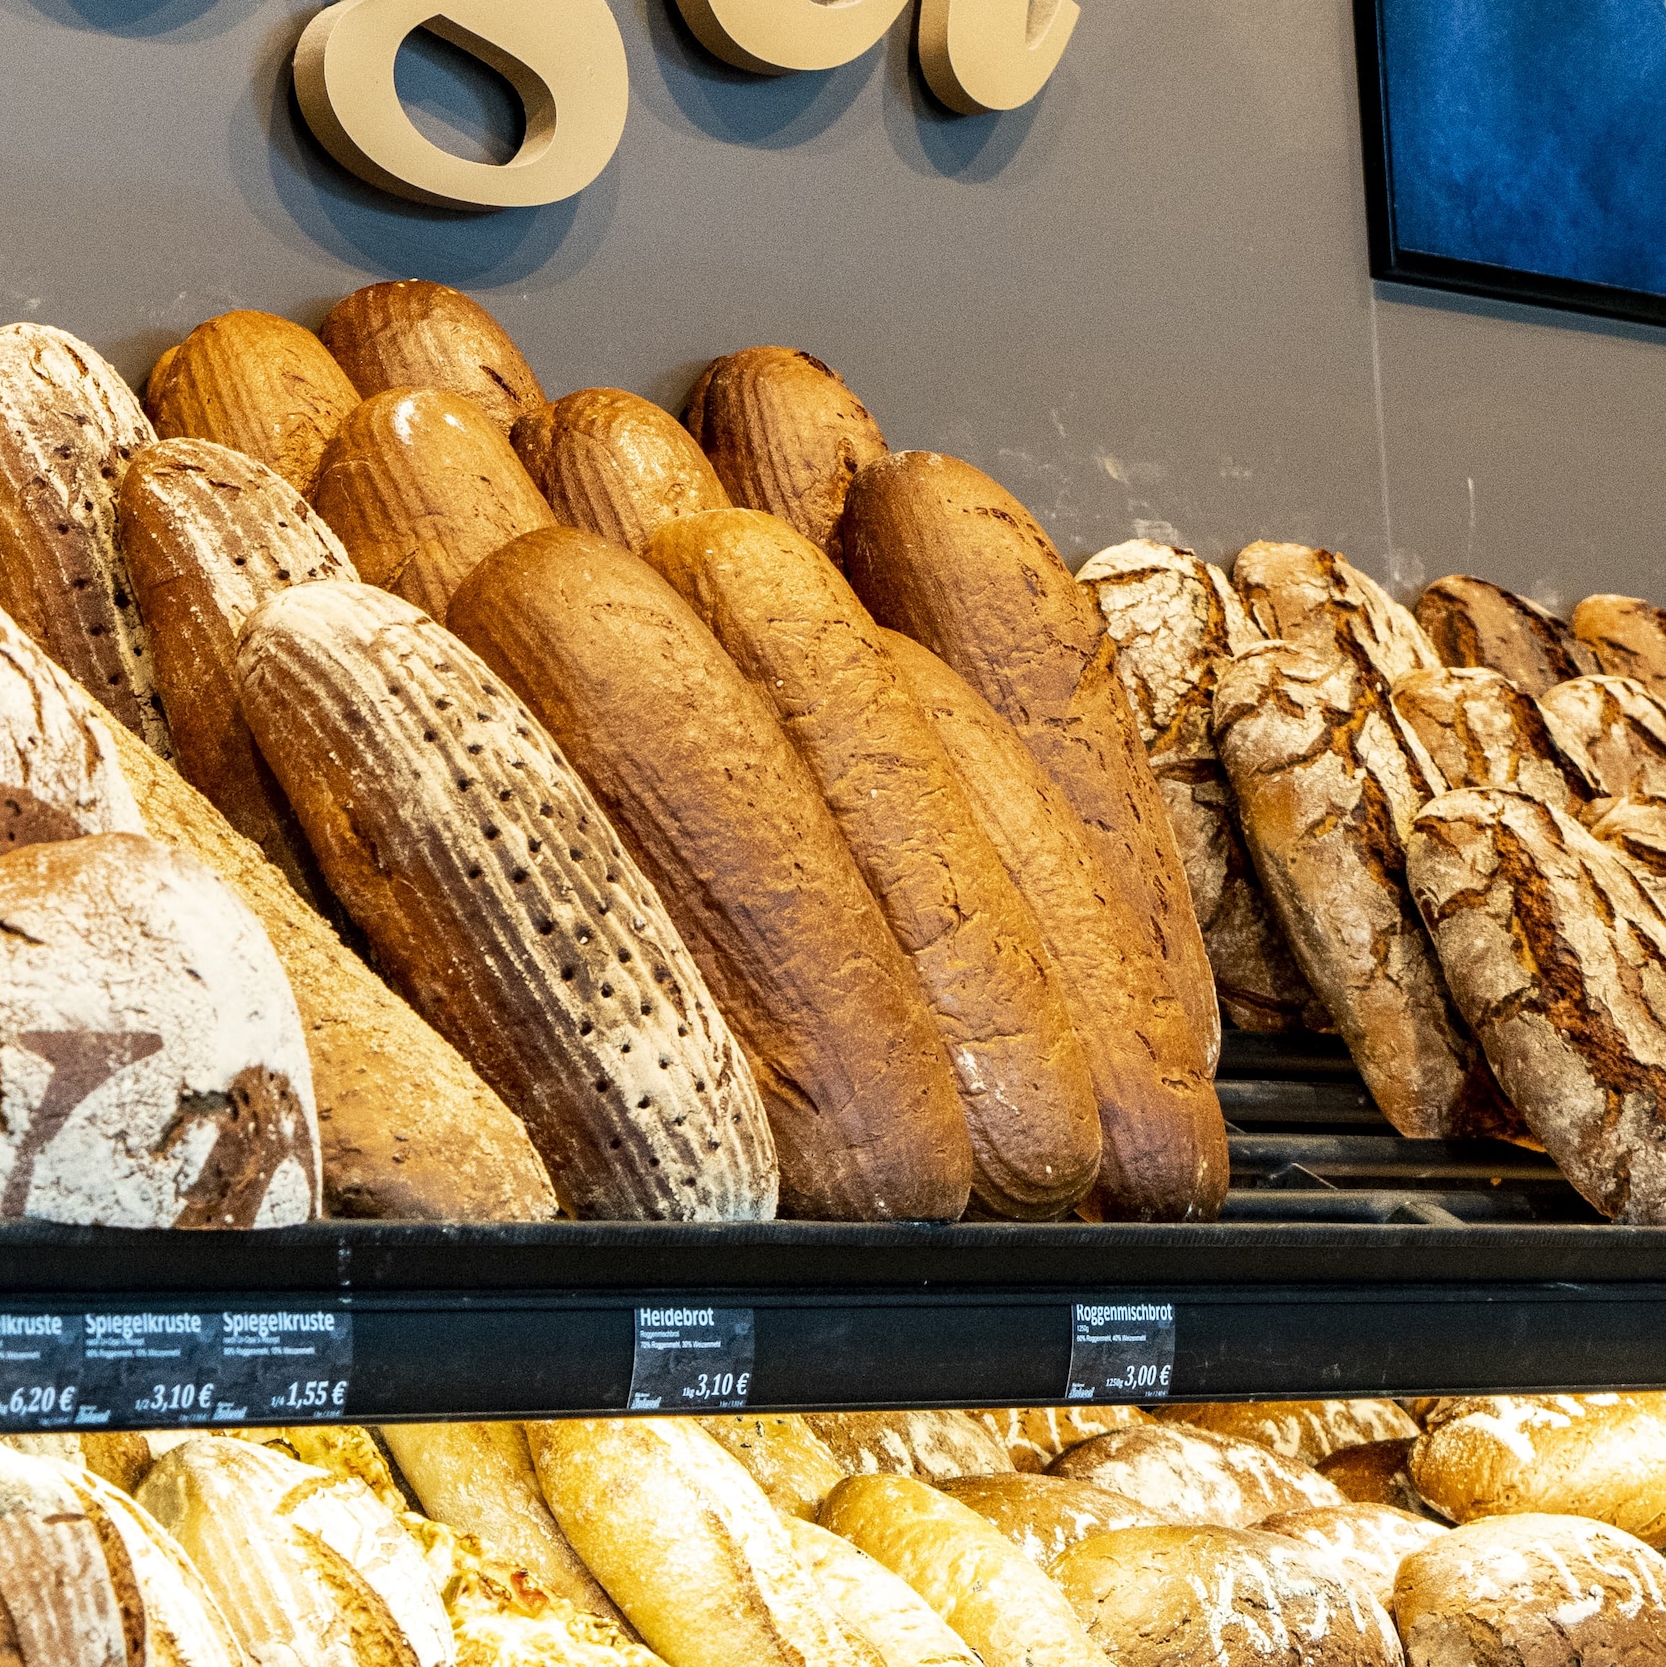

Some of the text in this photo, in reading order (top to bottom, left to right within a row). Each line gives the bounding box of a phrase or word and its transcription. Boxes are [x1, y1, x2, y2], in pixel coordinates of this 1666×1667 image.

[85, 1313, 201, 1339] Spiegelkruste
[223, 1312, 335, 1337] Spiegelkruste
[640, 1307, 715, 1327] Heidebrot
[1076, 1303, 1173, 1326] Roggenmischbrot
[695, 1373, 734, 1399] 3,10
[736, 1372, 750, 1395] €
[1124, 1365, 1157, 1389] 3,00
[1160, 1364, 1171, 1385] €
[9, 1386, 56, 1416] 6,20
[59, 1385, 77, 1412] €
[150, 1383, 195, 1413] 3,10
[198, 1383, 214, 1408] €
[286, 1380, 329, 1409] 1,55
[331, 1380, 349, 1405] €
